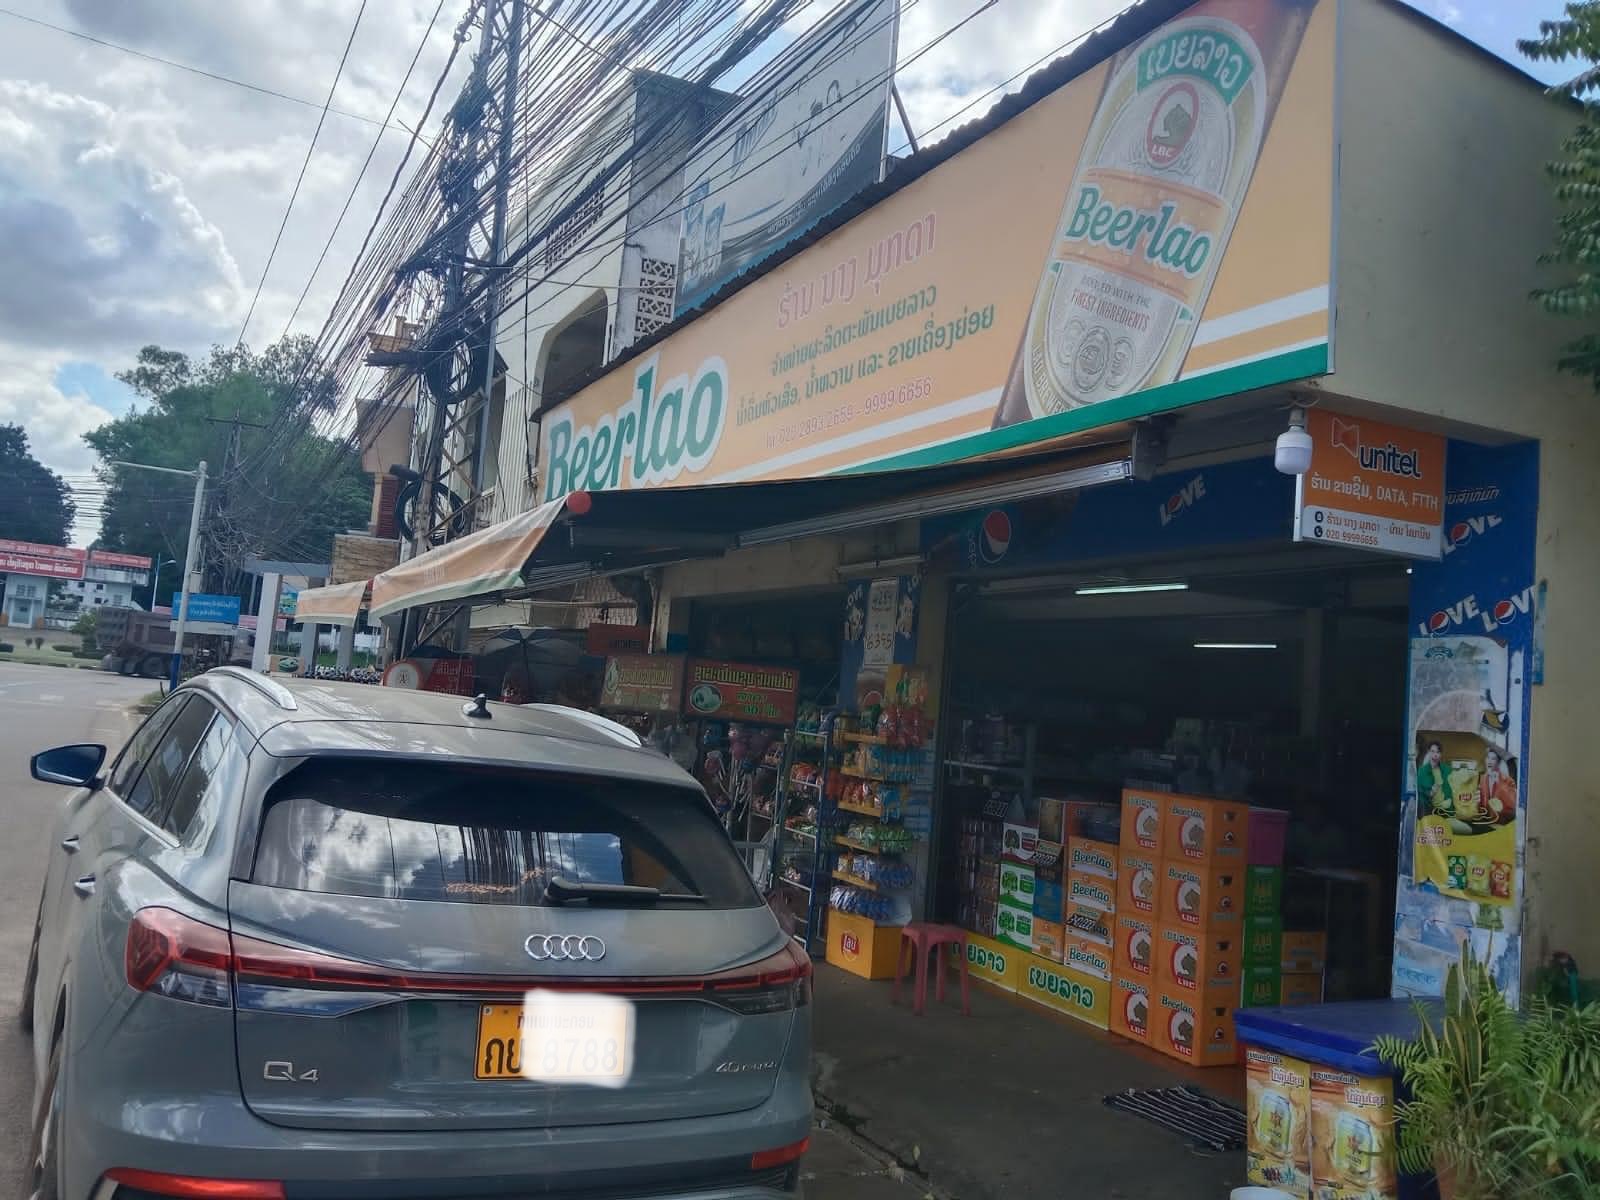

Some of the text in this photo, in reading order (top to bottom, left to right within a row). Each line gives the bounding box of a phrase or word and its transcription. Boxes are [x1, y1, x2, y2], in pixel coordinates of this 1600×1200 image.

[1146, 36, 1243, 90] ເບຍລາວ
[1065, 187, 1211, 275] Beerlao
[1096, 298, 1151, 331] INGREDIENTS
[857, 353, 884, 377] ແລະ
[544, 364, 724, 503] Beerlao
[1360, 443, 1422, 478] unitel
[1411, 491, 1440, 510] FTTH
[1073, 849, 1111, 870] Beerlao
[1072, 879, 1110, 902] Beerlao
[1069, 947, 1107, 970] Beerlao
[1029, 967, 1094, 1009] ເບຍລາວ
[263, 1061, 320, 1082] Q4
